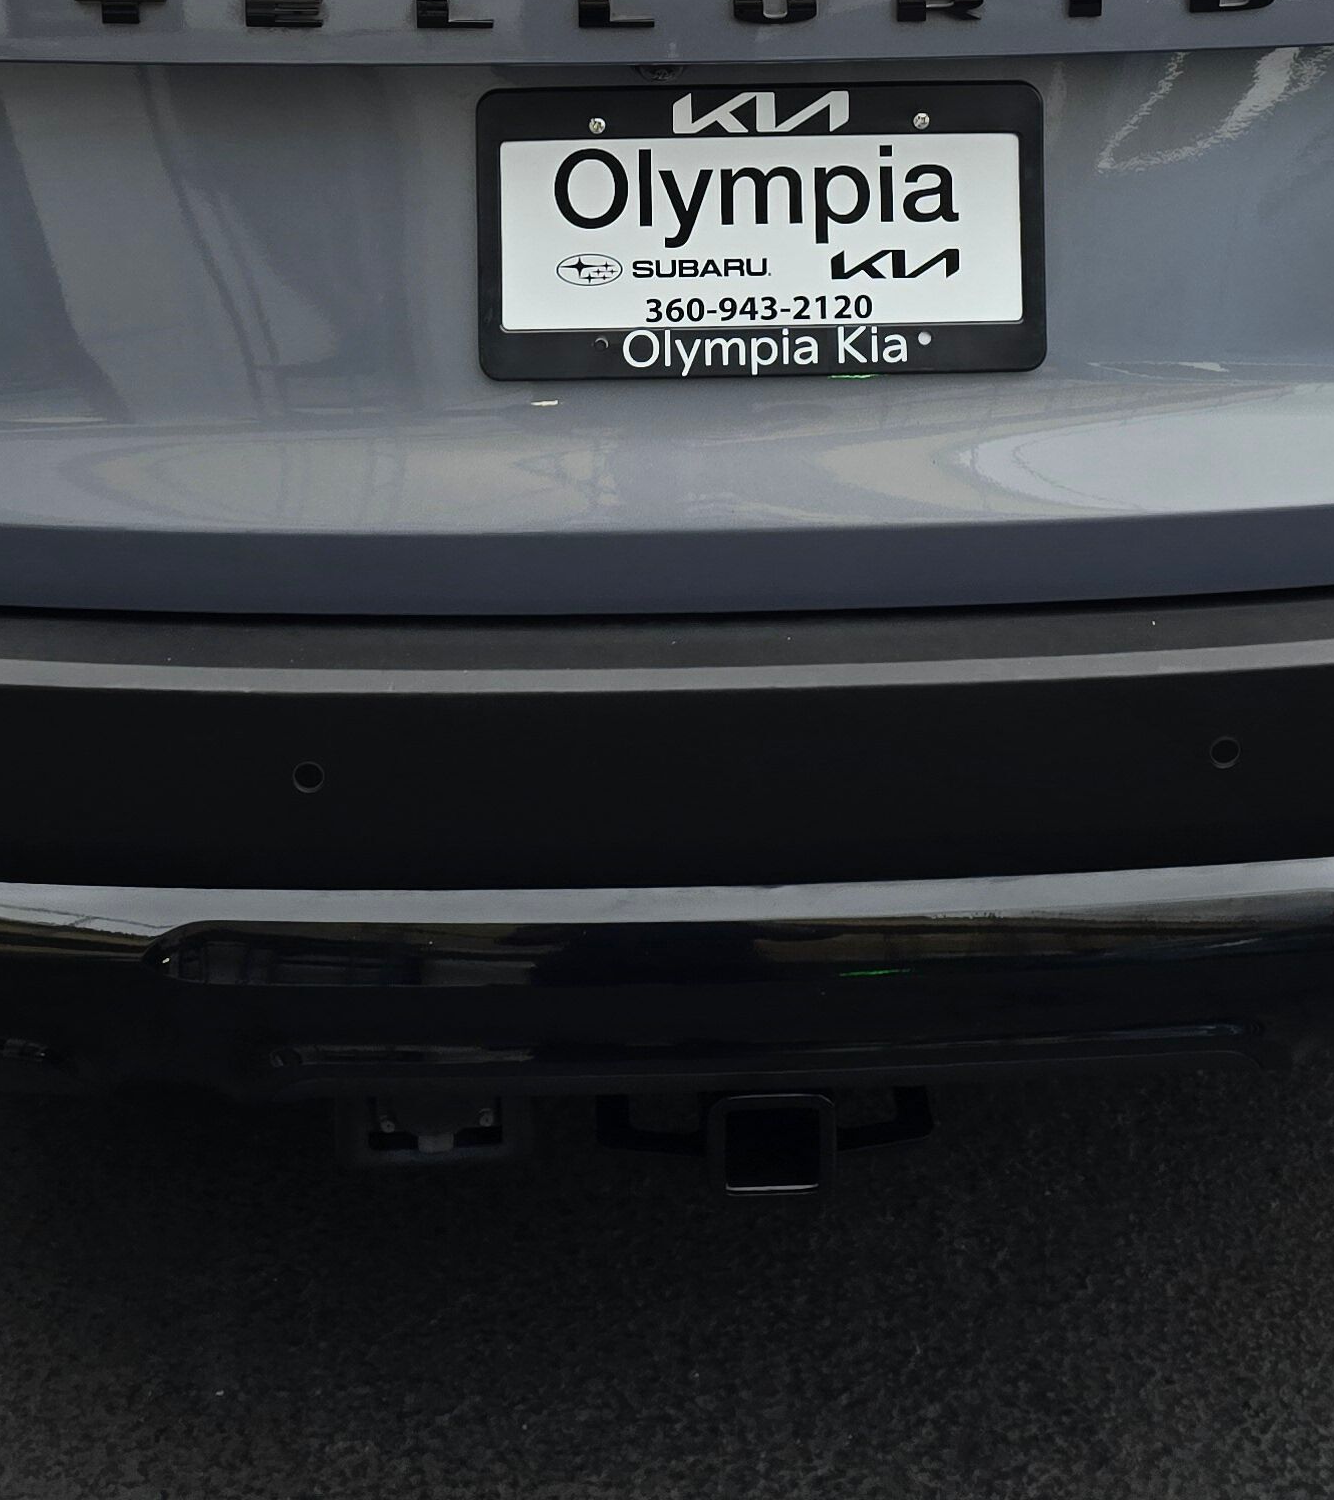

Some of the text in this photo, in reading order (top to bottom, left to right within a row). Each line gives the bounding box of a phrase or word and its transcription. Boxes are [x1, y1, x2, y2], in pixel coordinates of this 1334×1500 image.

[672, 90, 850, 134] KIA
[554, 145, 960, 249] Olympia
[632, 257, 768, 279] SUBARU
[830, 248, 960, 280] KIA
[645, 294, 874, 324] 360-943-2120
[622, 325, 909, 377] Olympia Kia
